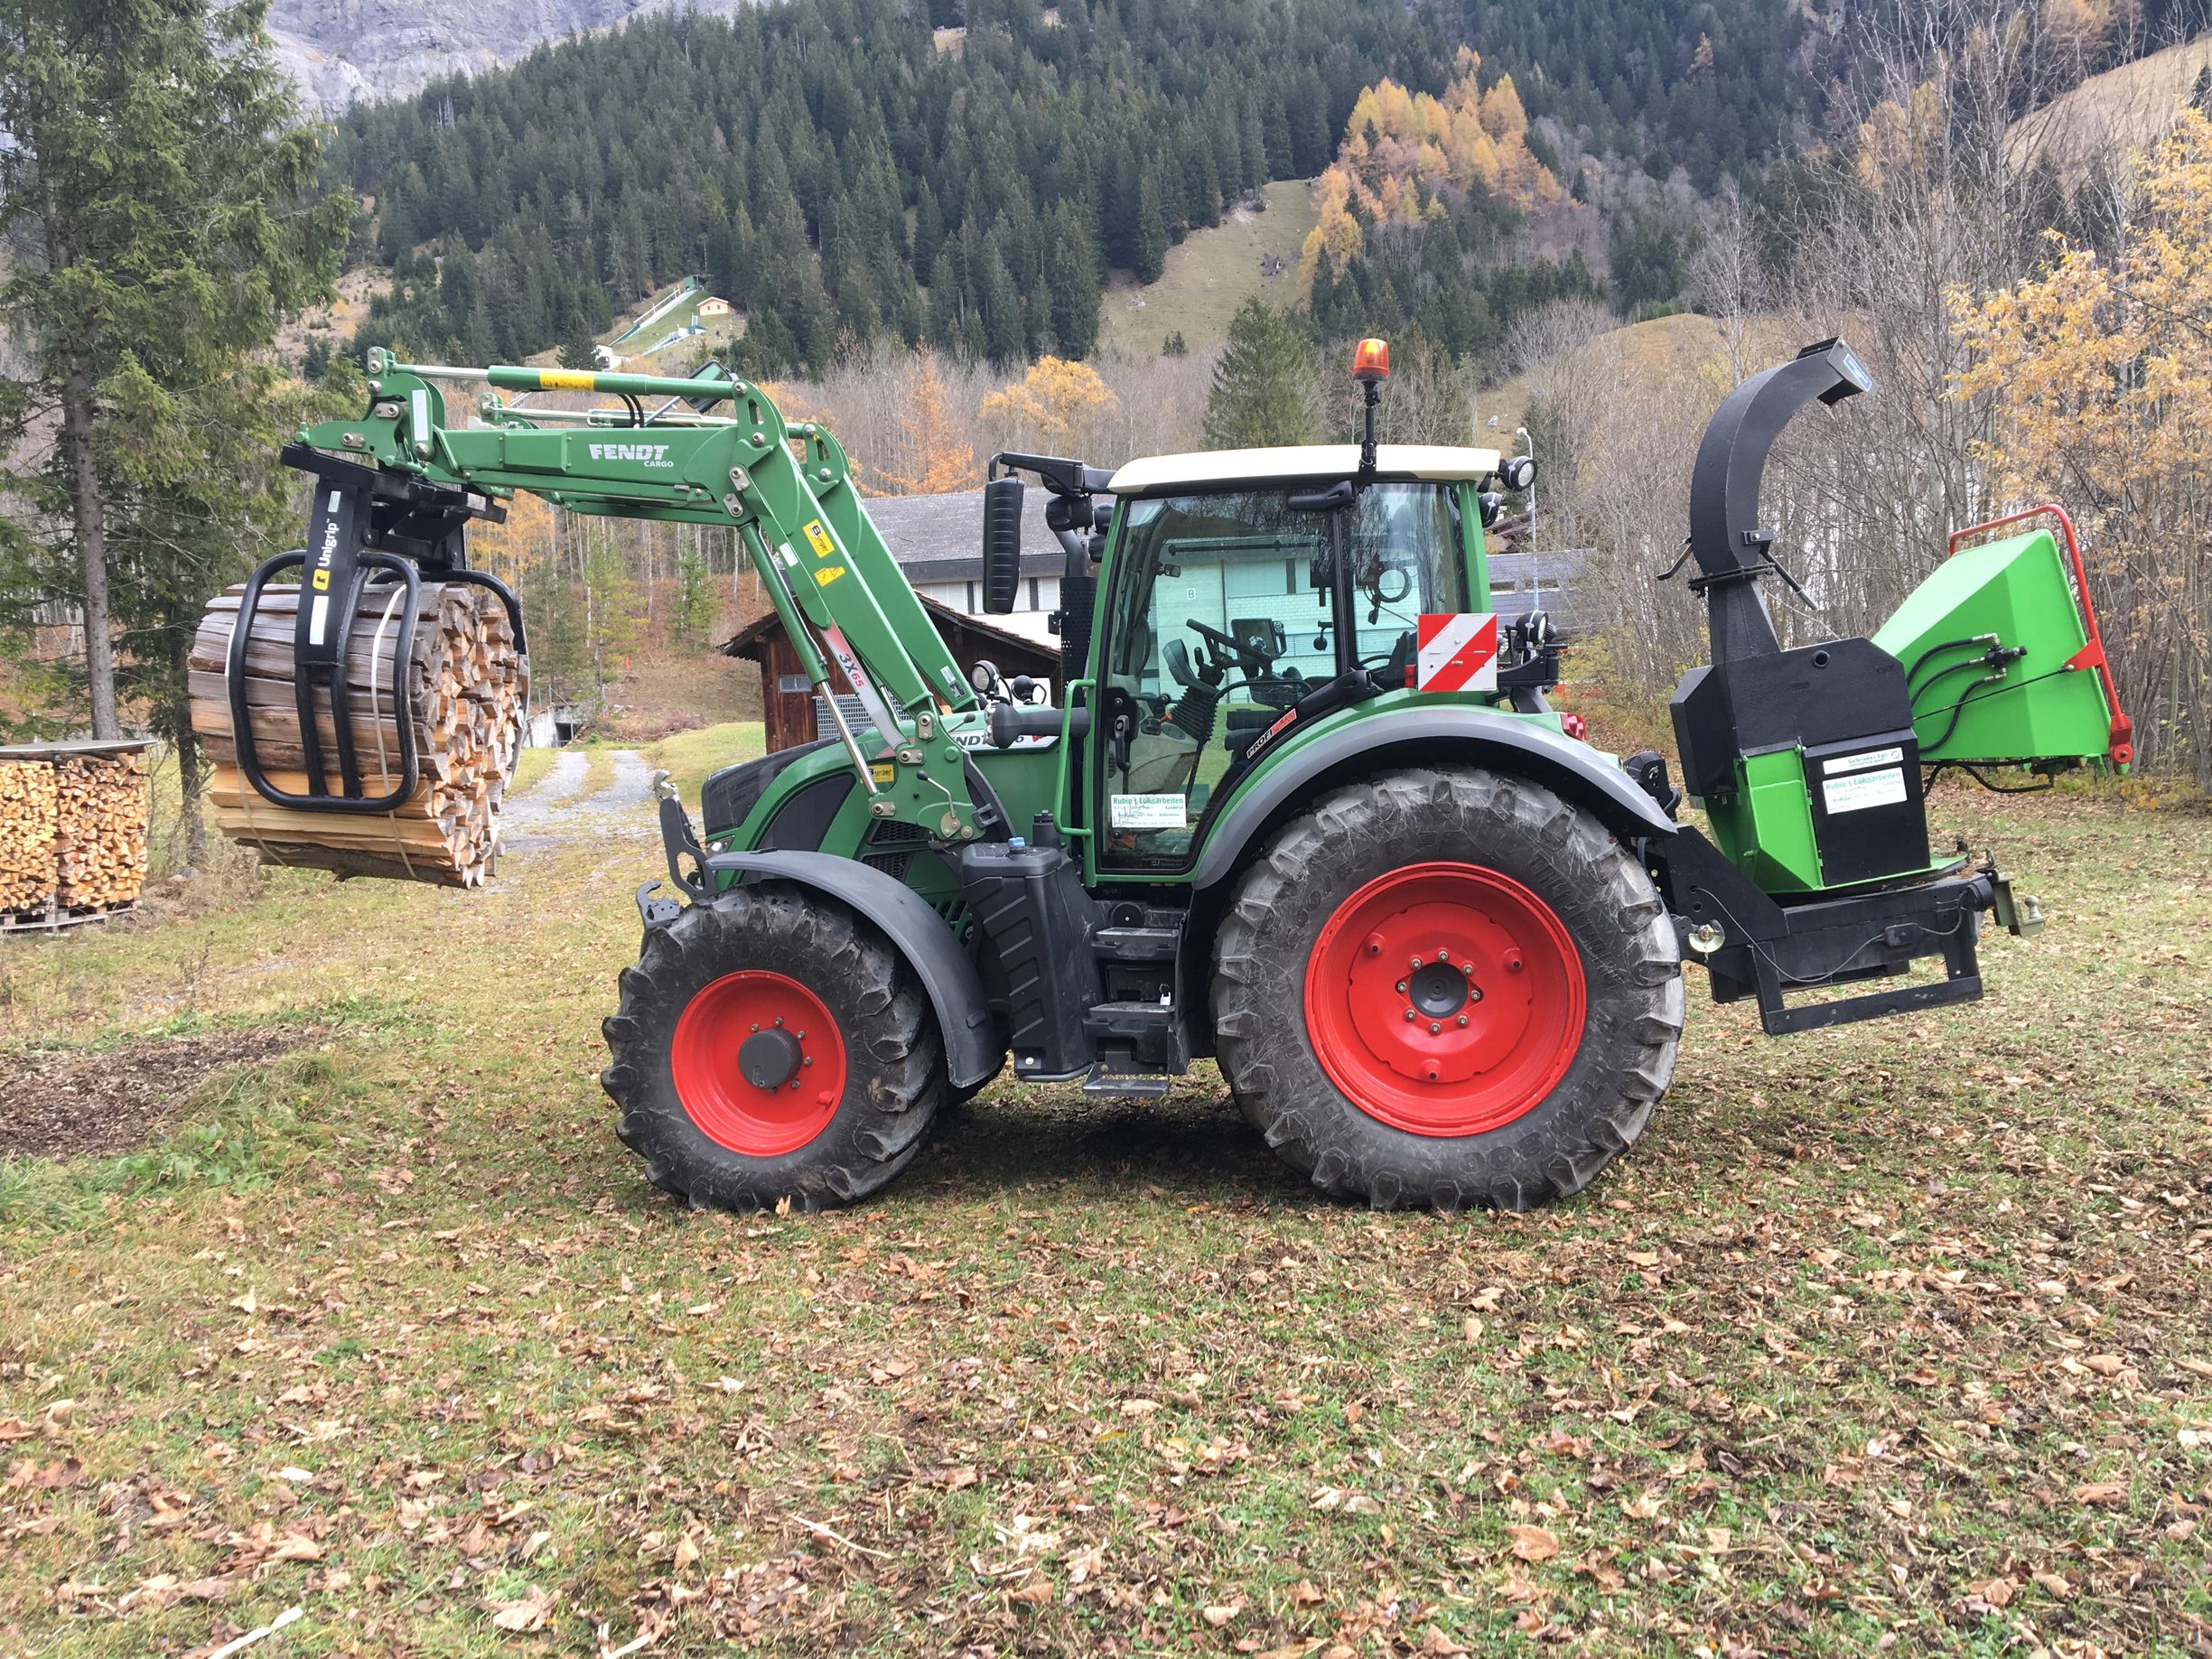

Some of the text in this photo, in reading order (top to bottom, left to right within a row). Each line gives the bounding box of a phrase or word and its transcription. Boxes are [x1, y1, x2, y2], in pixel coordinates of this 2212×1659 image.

[589, 444, 669, 460] FENDT
[1188, 589, 1195, 598] B
[953, 735, 987, 746] NDT
[1247, 729, 1273, 757] PROFI
[1139, 797, 1183, 805] Lohnarbeiten
